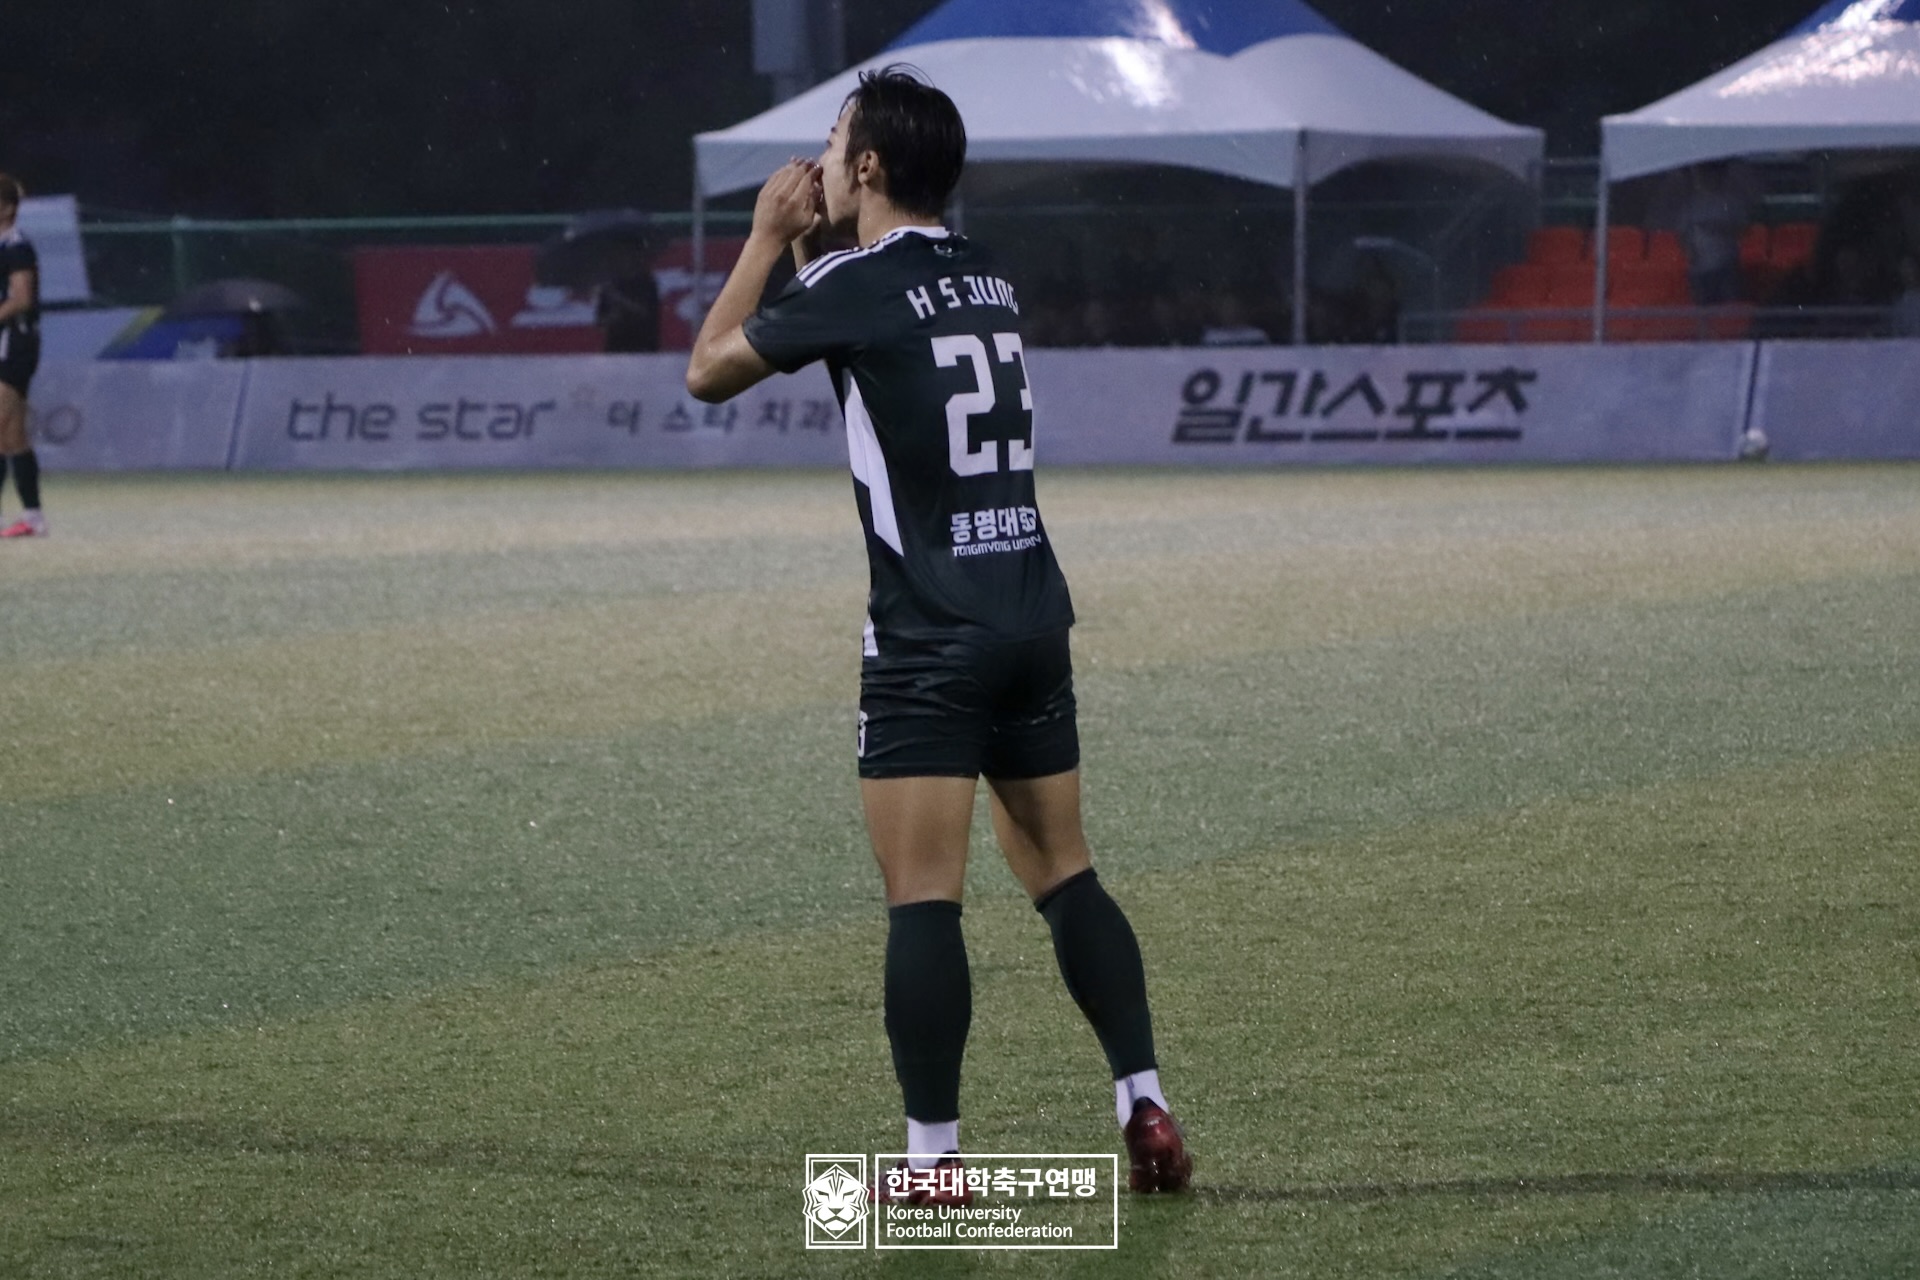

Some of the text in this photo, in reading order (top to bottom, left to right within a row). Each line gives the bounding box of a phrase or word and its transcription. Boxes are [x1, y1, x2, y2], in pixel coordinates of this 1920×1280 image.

[904, 285, 937, 320] H
[938, 277, 963, 310] S
[287, 390, 557, 442] the star
[930, 332, 1036, 477] 23
[1171, 365, 1537, 444] 일간스포츠
